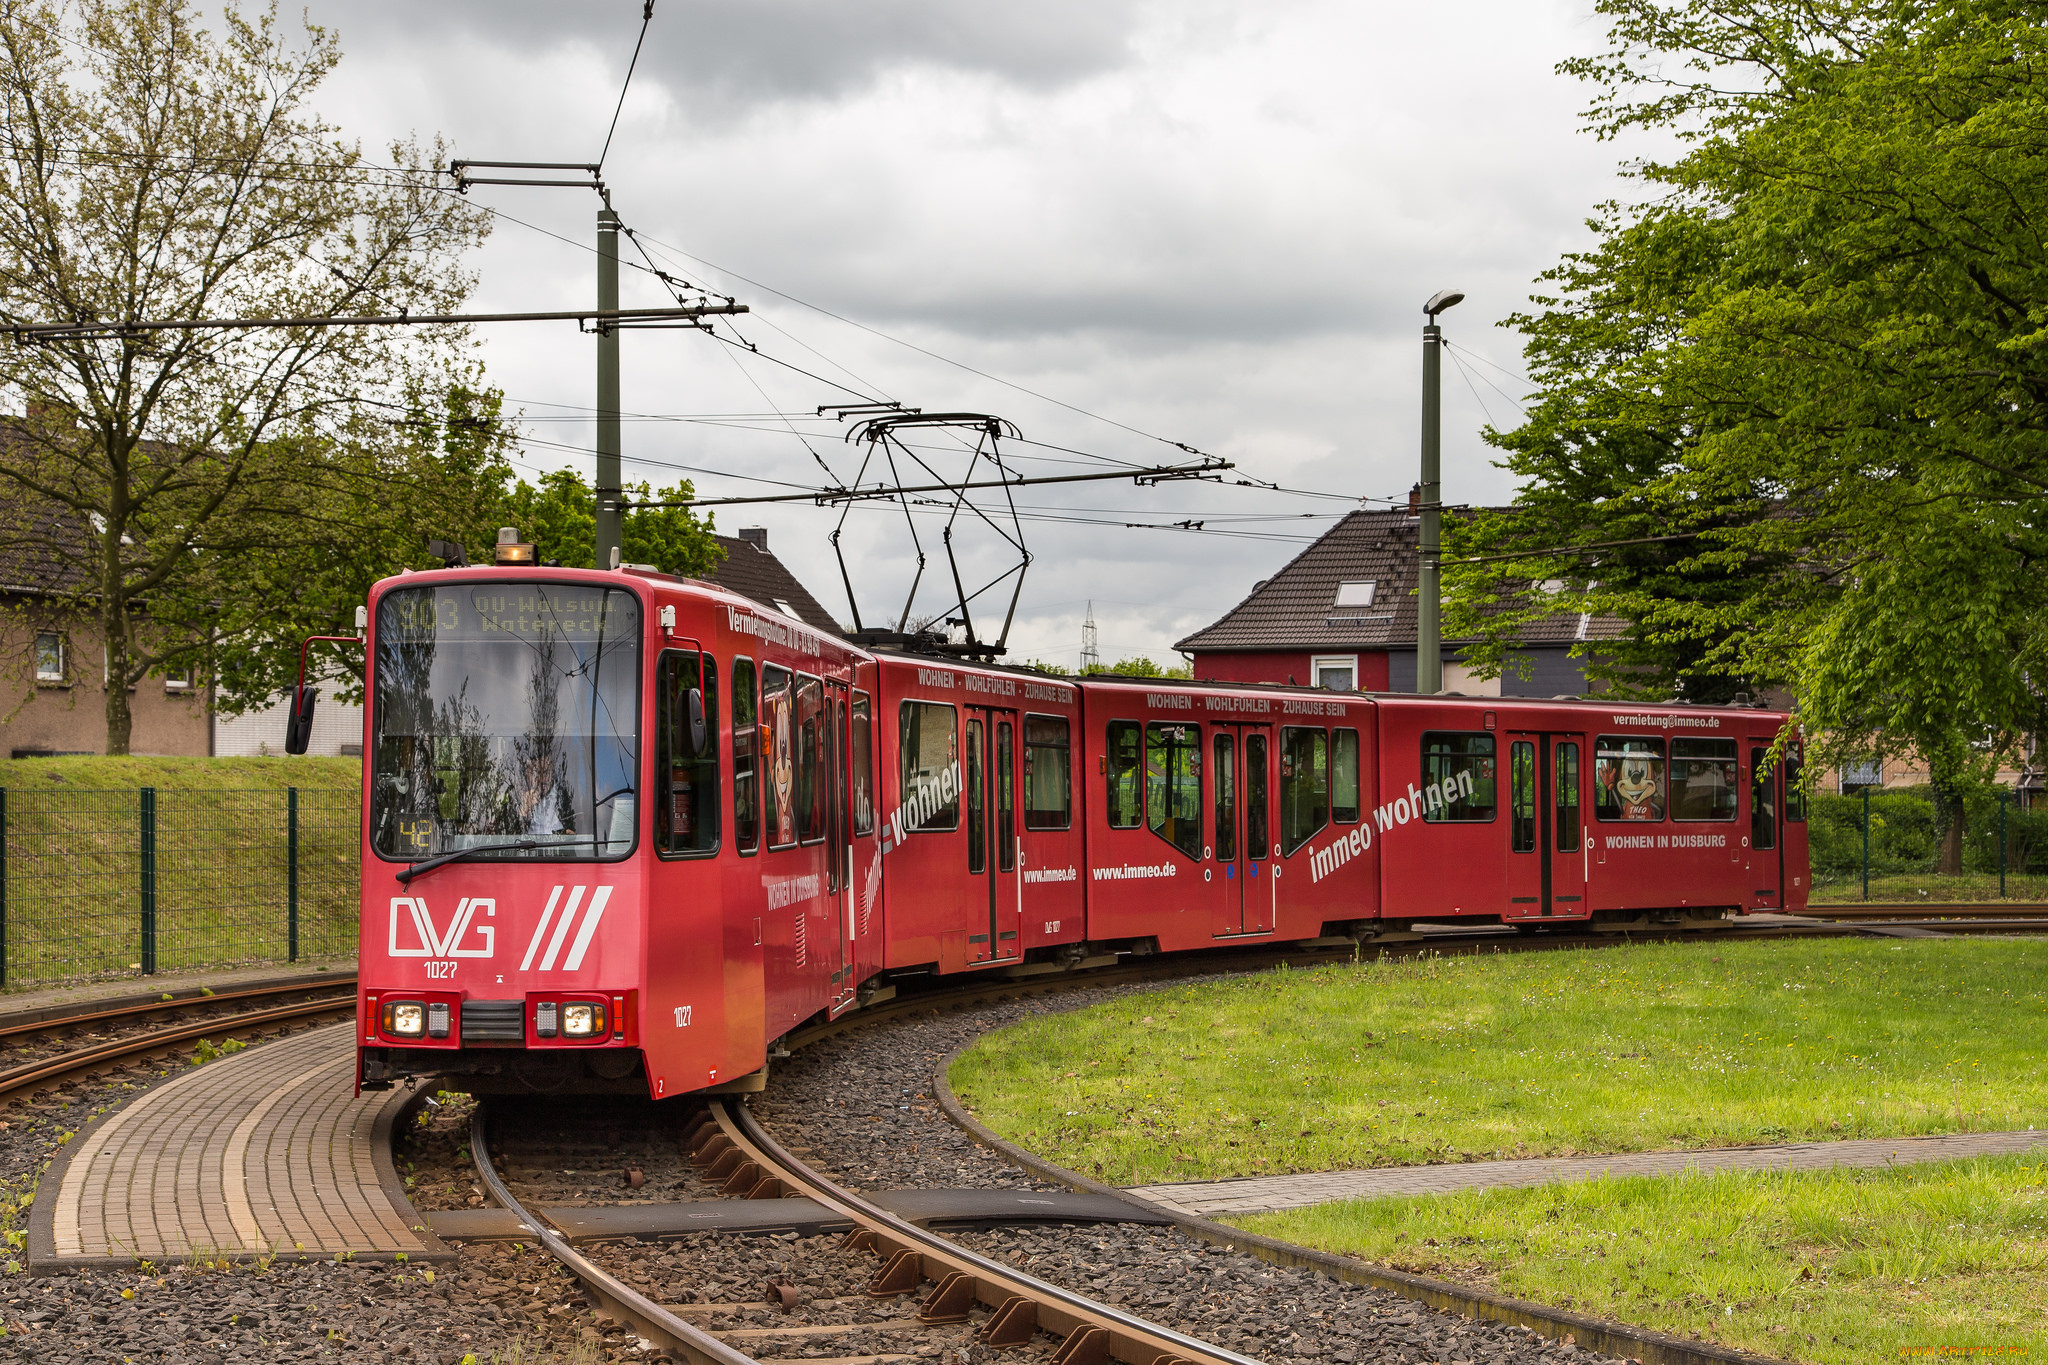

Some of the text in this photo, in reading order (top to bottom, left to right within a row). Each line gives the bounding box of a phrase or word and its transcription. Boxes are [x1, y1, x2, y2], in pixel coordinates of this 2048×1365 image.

[400, 598, 458, 630] 903
[482, 615, 607, 632] Watereck
[917, 668, 1073, 704] WOHNEN WOHLFÜHLEN ZUHAUSE SEIN
[1146, 693, 1347, 717] WOHNEN WOHLFÜHLEN ZUHAUSE SEIN
[1613, 714, 1720, 729] vermietung@immeo.de
[890, 759, 963, 847] wohnen
[400, 820, 432, 847] 42
[1308, 768, 1474, 883] immeo wohnen
[1605, 834, 1726, 849] WOHNEN IN DUISBURG
[1024, 864, 1077, 883] www.immeo.de
[1092, 861, 1176, 881] www.immeo.de
[767, 880, 790, 911] WOHNEN
[388, 897, 496, 958] DVG
[423, 961, 458, 979] 1027
[673, 1005, 692, 1028] 1027
